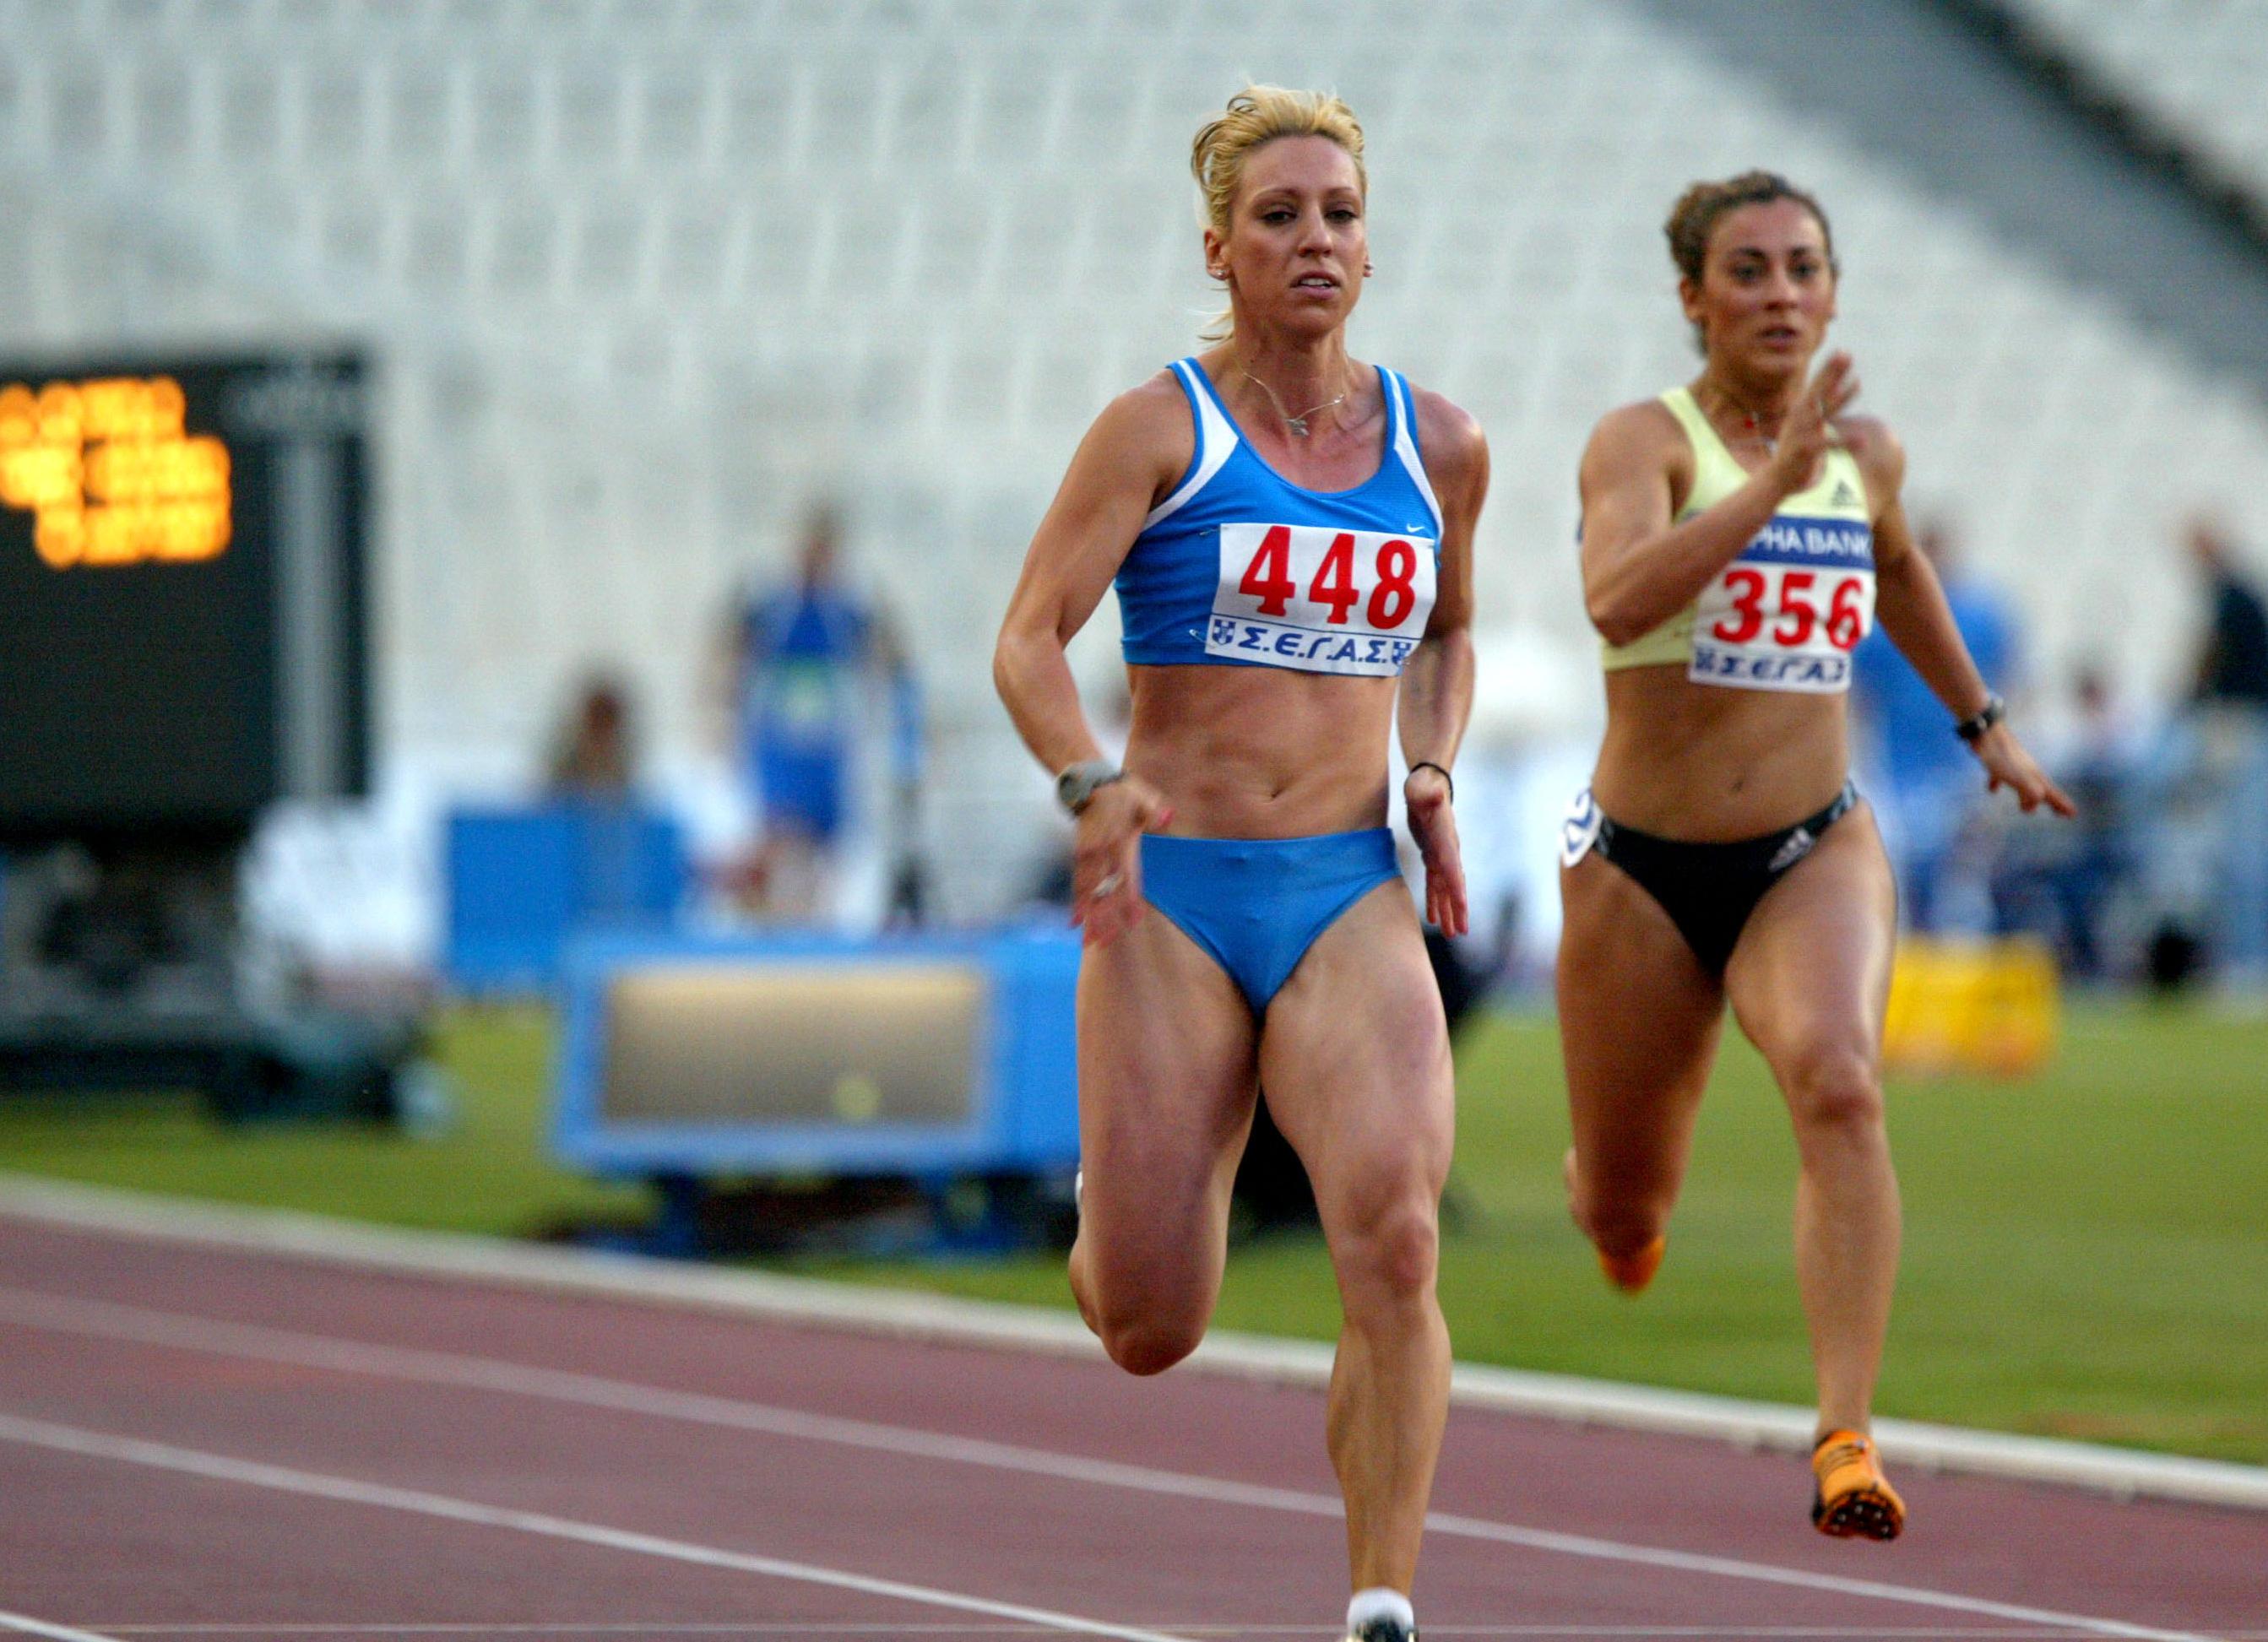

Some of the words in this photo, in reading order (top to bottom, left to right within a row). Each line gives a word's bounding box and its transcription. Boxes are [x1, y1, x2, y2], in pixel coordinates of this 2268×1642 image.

[1239, 525, 1417, 630] 448
[1804, 528, 1871, 556] BANK
[1712, 570, 1864, 653] 356
